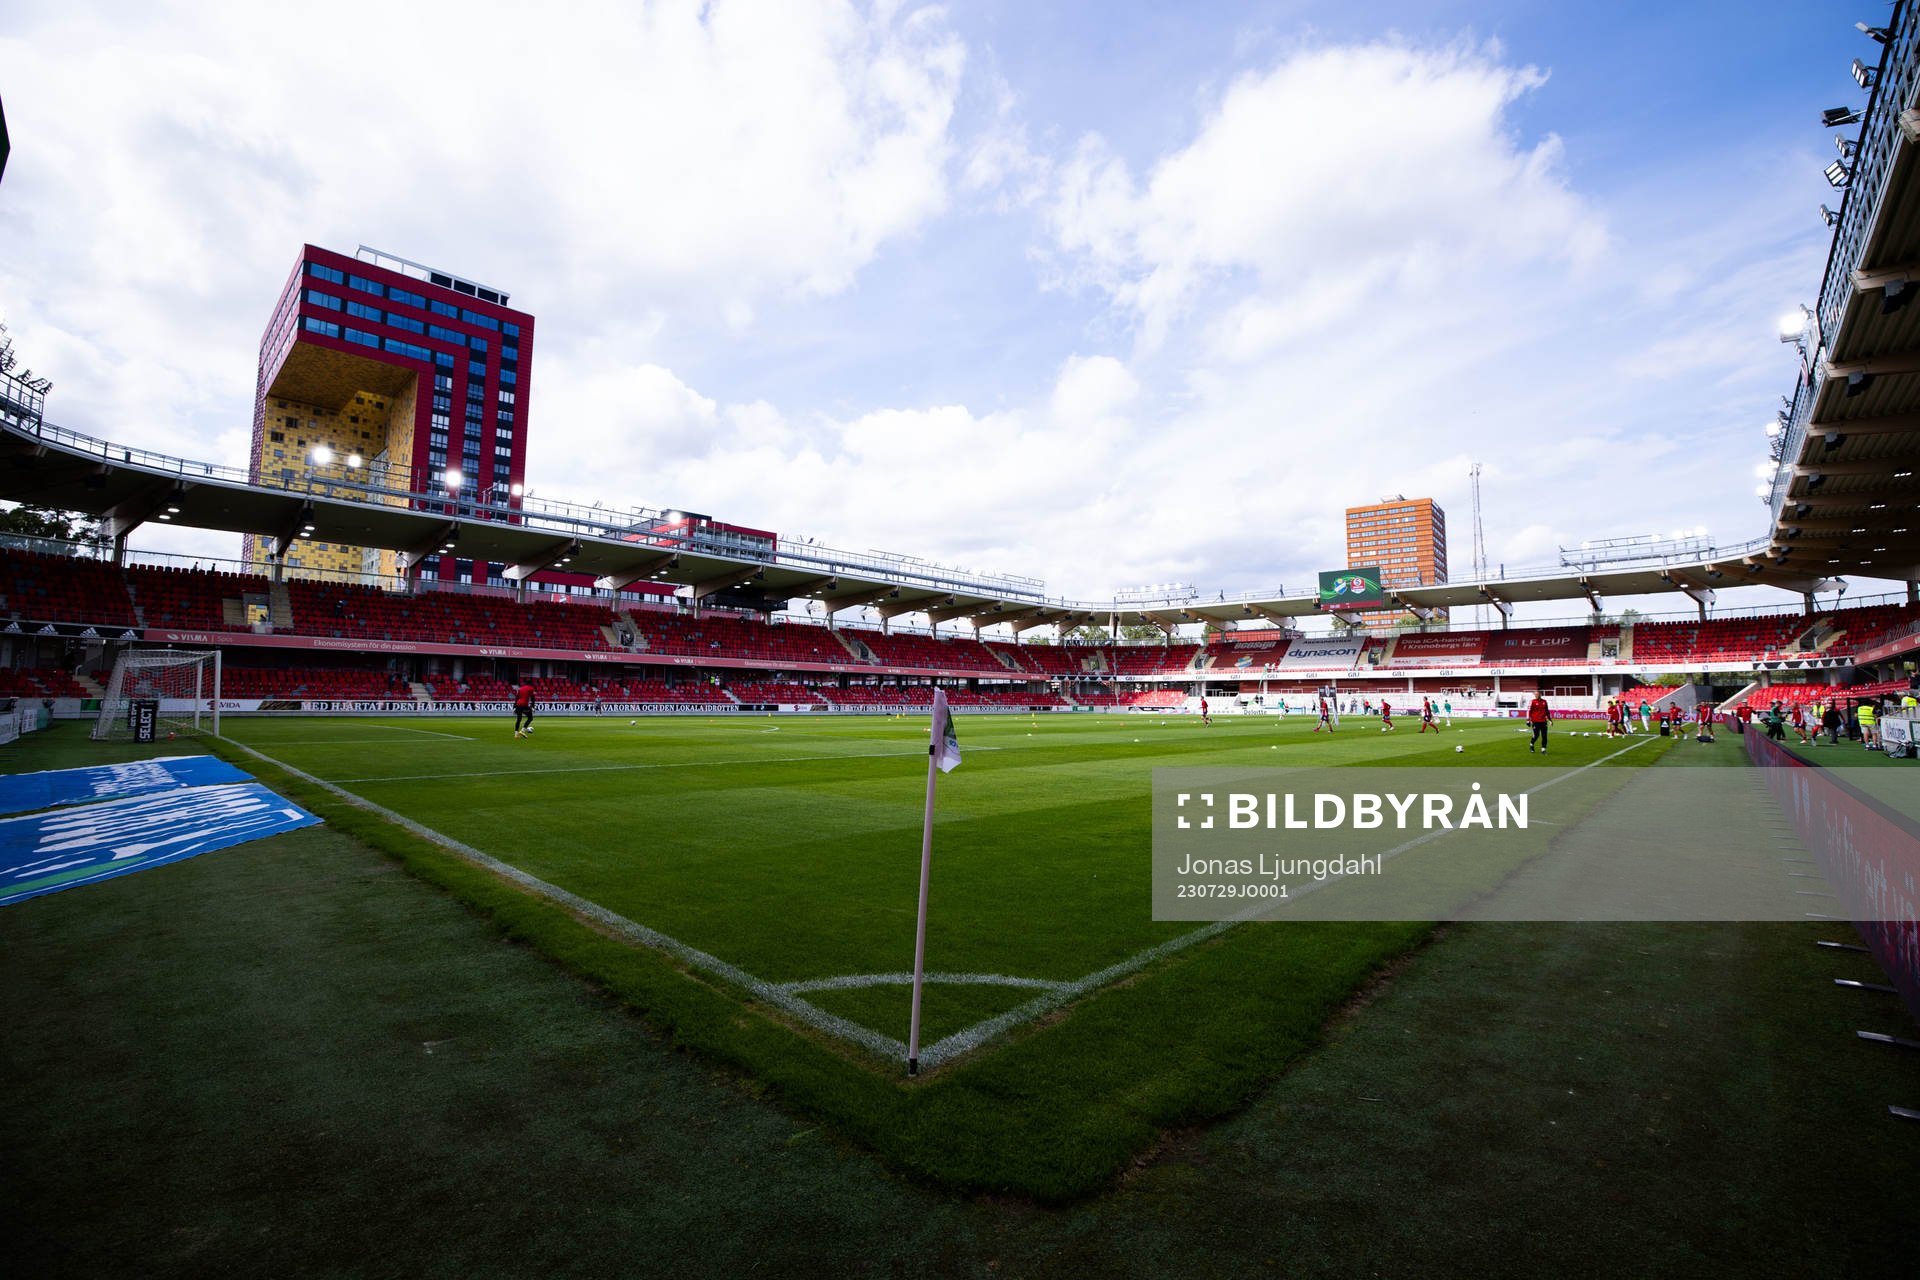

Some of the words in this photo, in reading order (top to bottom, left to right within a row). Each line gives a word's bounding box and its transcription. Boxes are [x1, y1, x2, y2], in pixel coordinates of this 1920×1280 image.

[181, 633, 208, 642] VISMA
[1542, 637, 1571, 646] CUP
[313, 640, 368, 649] Ekonomisystem
[1288, 648, 1357, 658] dynacon
[300, 701, 329, 711] MED
[392, 702, 415, 711] DEN
[587, 703, 640, 712] TVARORNA
[642, 704, 658, 712] OCH
[660, 704, 675, 712] DEN
[676, 704, 703, 712] LOKALA
[139, 708, 153, 739] SELECT
